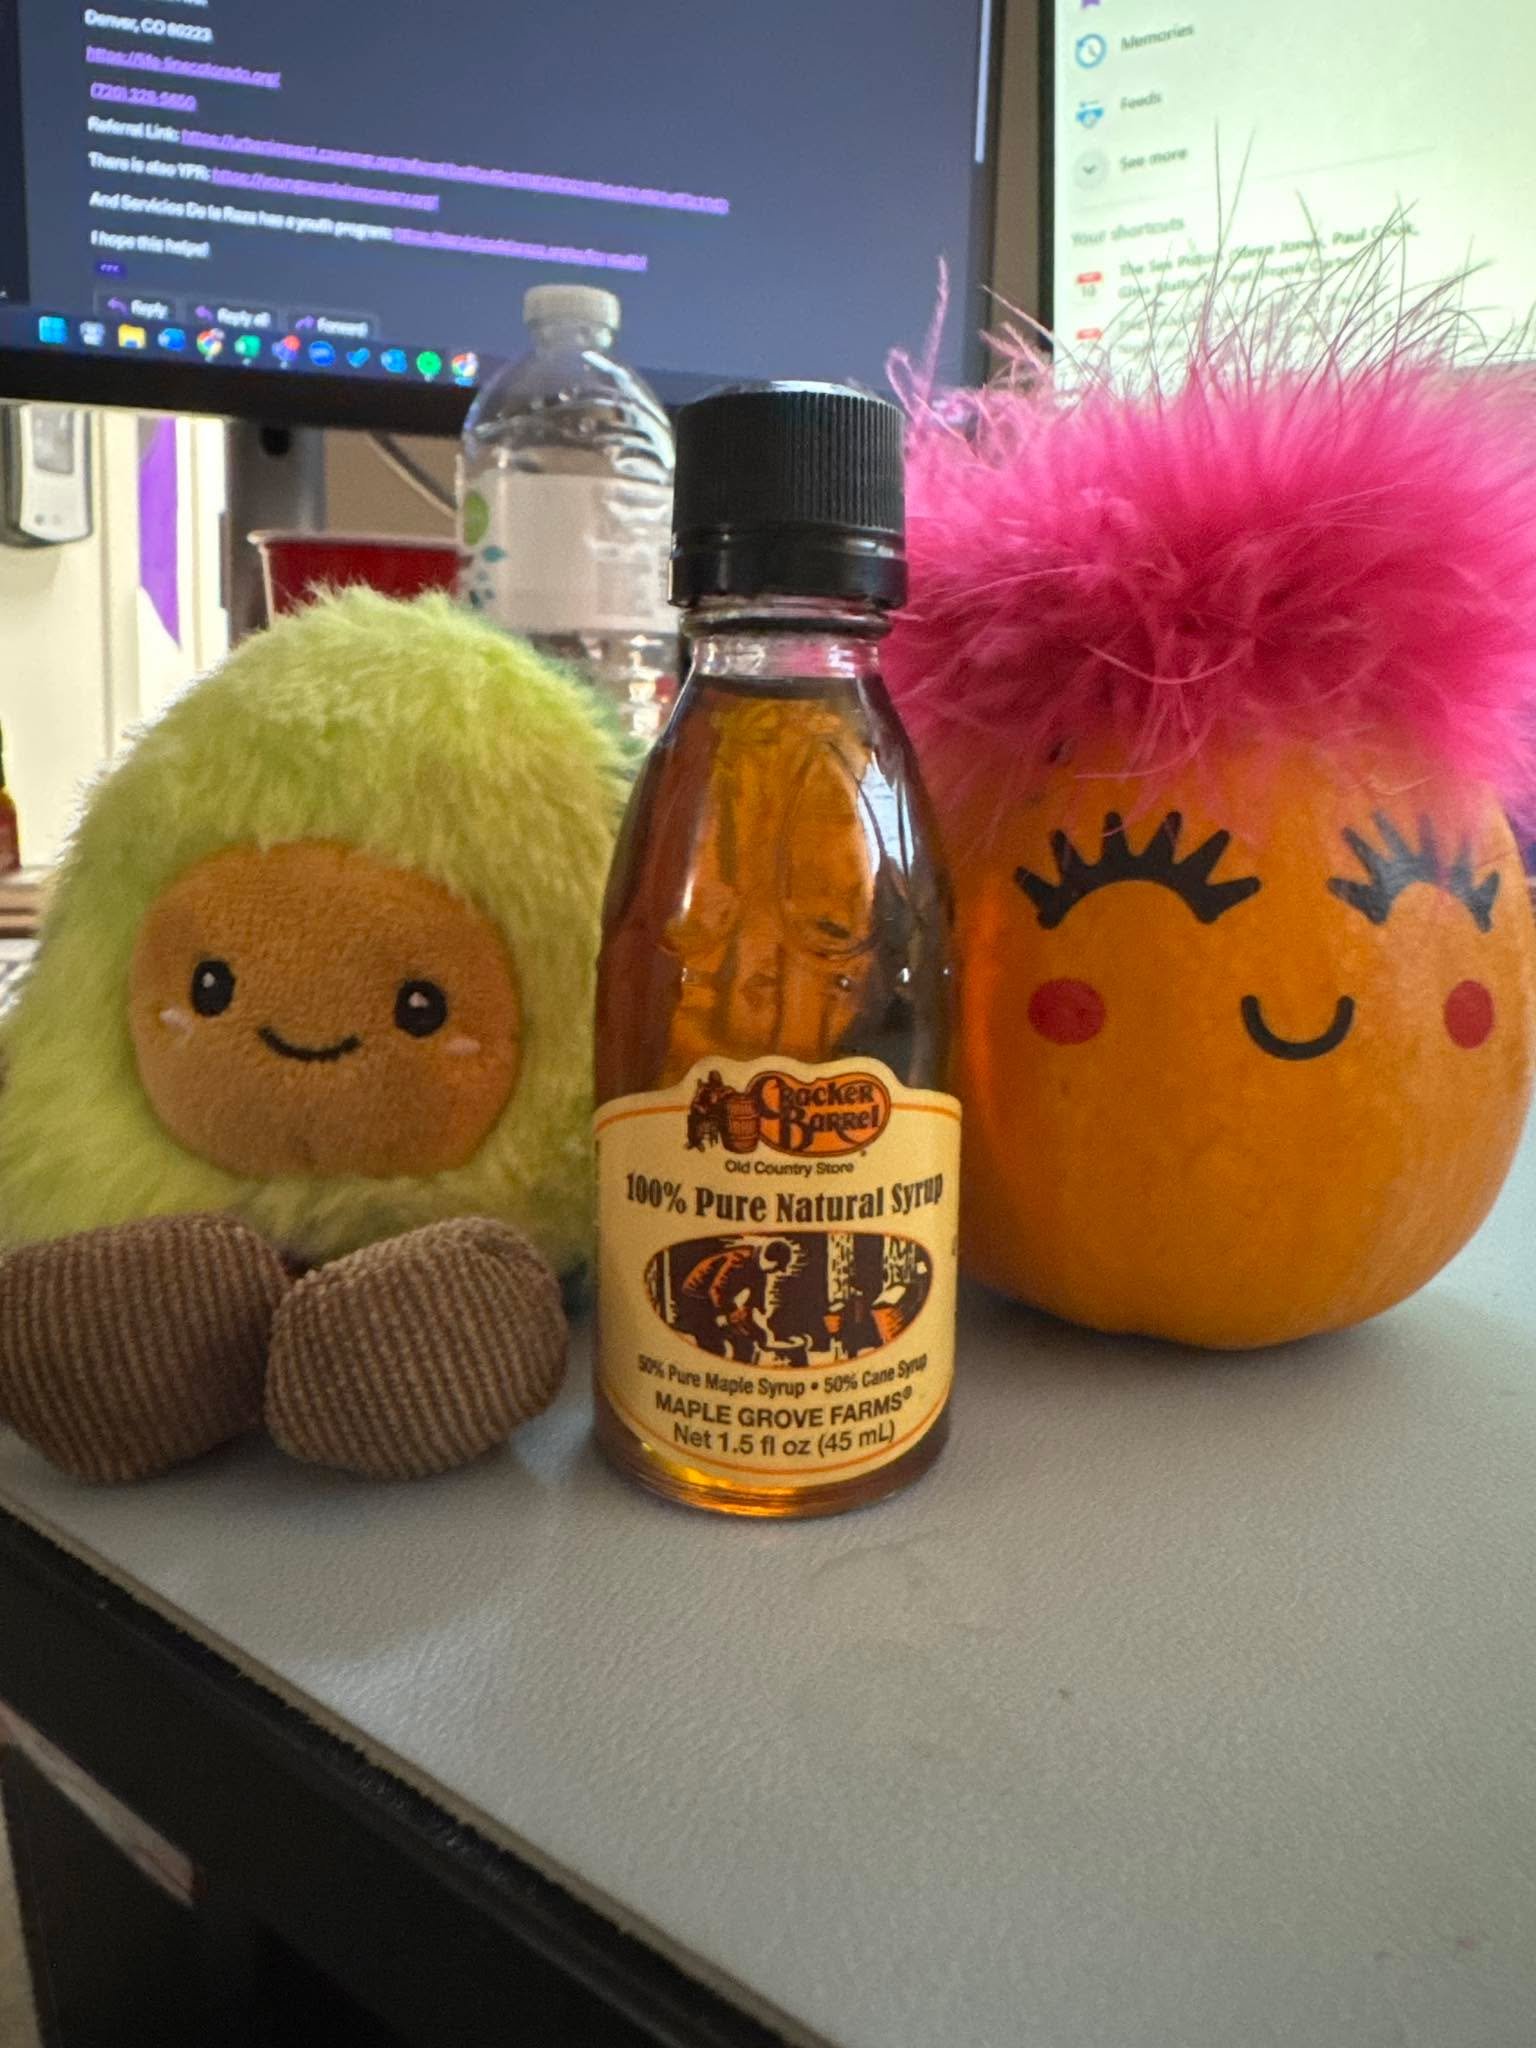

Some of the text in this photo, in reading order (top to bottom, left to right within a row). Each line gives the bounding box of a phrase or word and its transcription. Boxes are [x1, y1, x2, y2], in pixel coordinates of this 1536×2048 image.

[140, 17, 166, 36] CO
[1120, 24, 1194, 51] Memories
[1120, 91, 1162, 110] Feeds
[1120, 149, 1188, 171] See more
[752, 1075, 875, 1119] Cracker
[780, 1104, 880, 1152] Barrel
[725, 1159, 855, 1178] Old Country Store
[626, 1172, 944, 1224] 100% Pure Natural Syrup
[668, 1365, 701, 1388] Pure
[705, 1372, 754, 1396] Maple
[758, 1377, 806, 1400] Syrup
[824, 1374, 858, 1395] 50%
[862, 1366, 896, 1386] Cane
[898, 1352, 929, 1380] Syrup
[655, 1390, 732, 1426] MAPLE
[737, 1406, 824, 1429] GROVE
[673, 1418, 897, 1459] Net 1.5 fl oz (45 mL)
